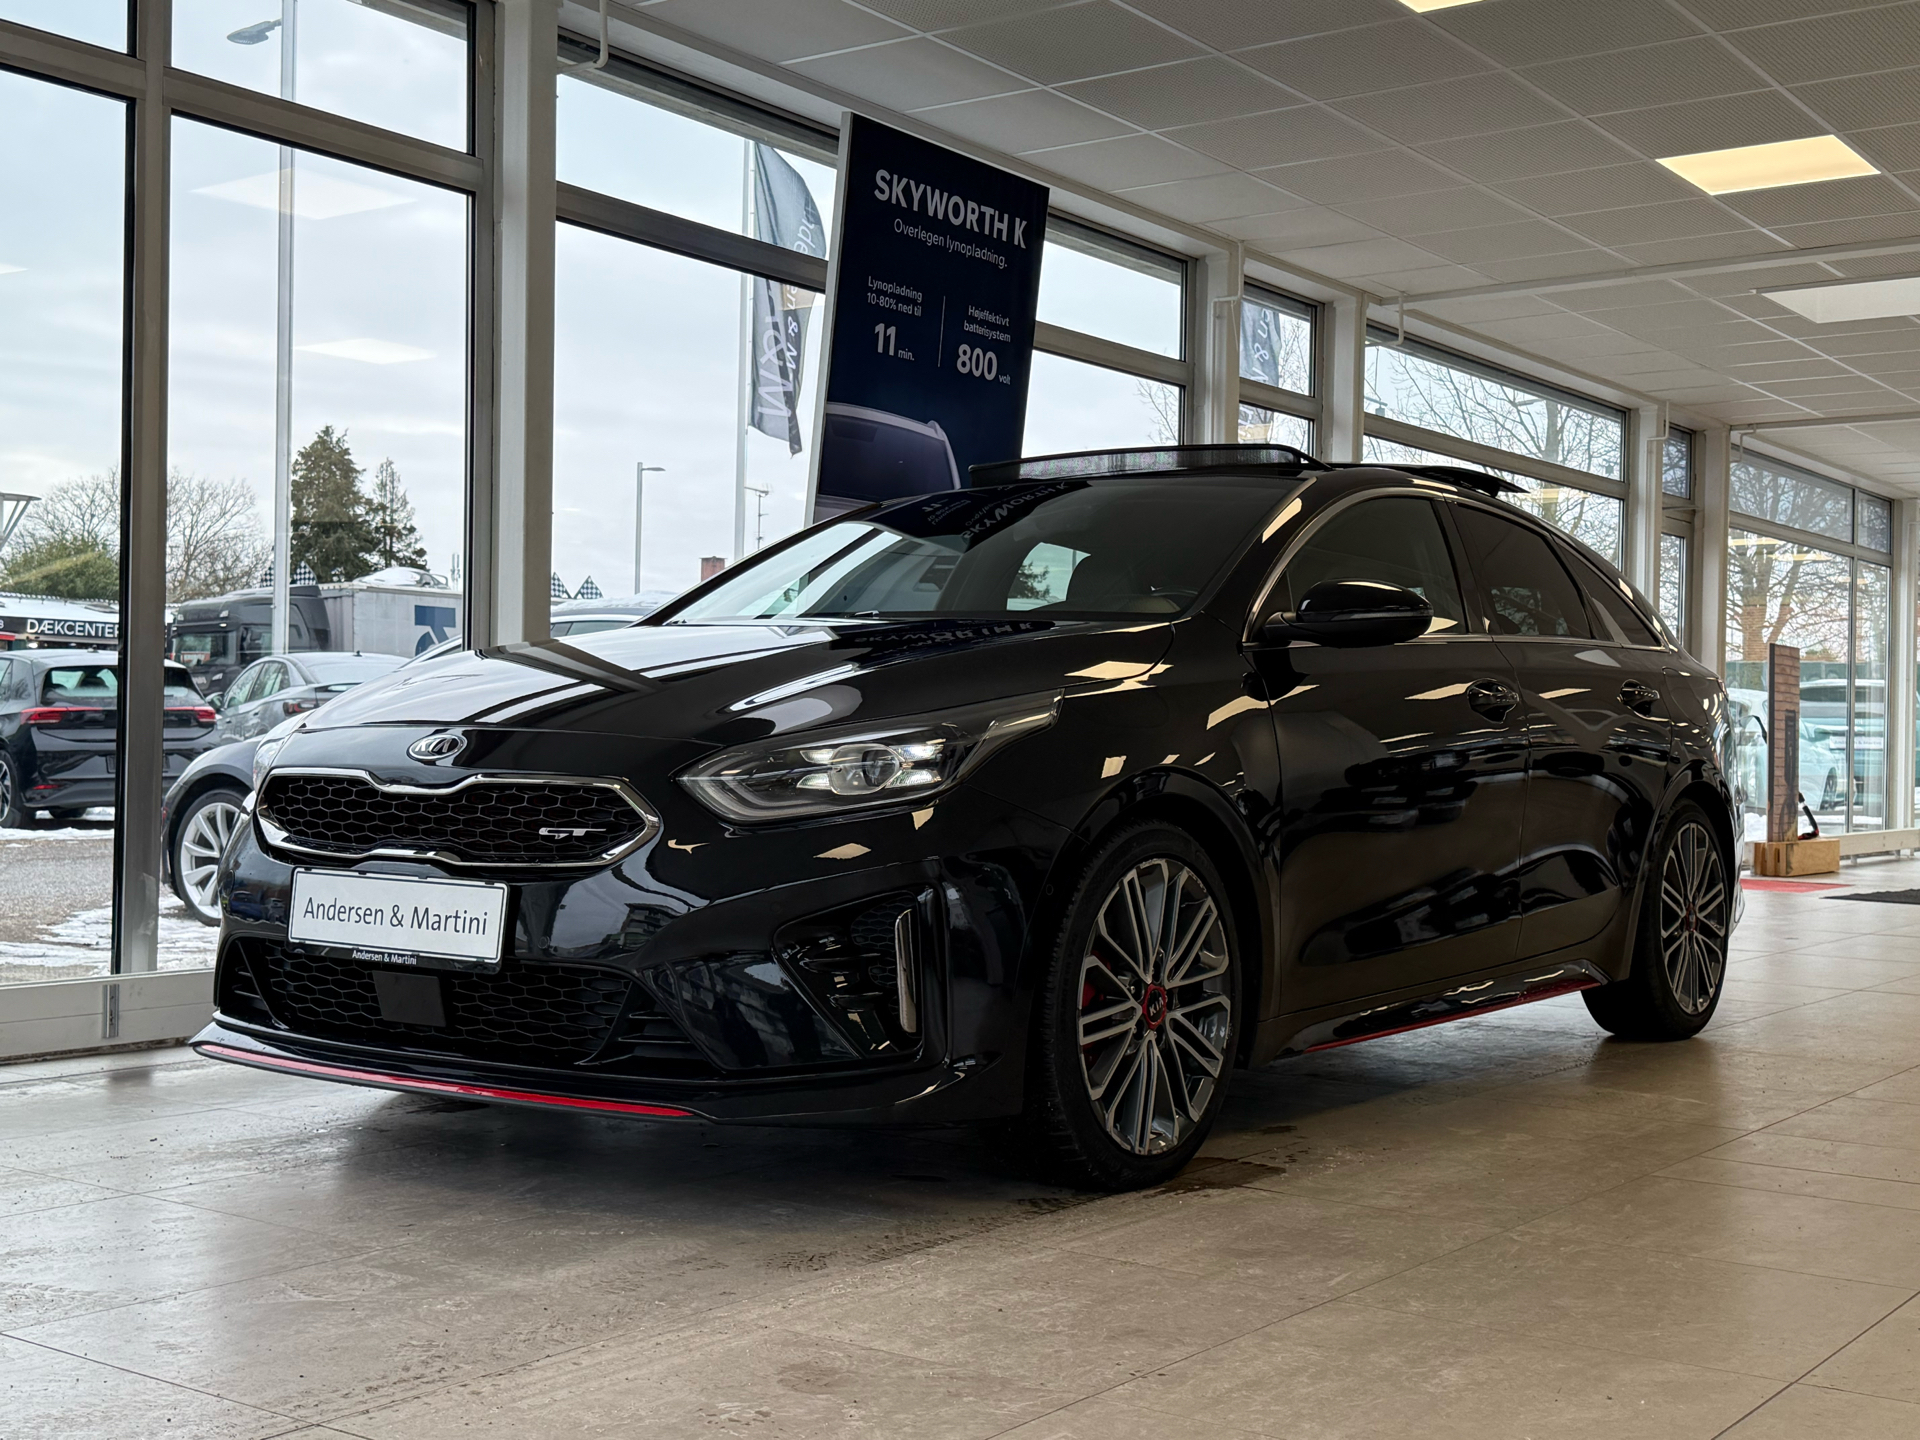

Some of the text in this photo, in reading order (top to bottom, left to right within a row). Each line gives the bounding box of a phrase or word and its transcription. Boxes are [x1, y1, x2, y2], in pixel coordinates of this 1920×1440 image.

[874, 169, 1028, 249] SKYWORTH K
[894, 218, 1008, 270] Overlegen lynopladning.
[868, 276, 923, 303] Lynopladning
[867, 293, 922, 317] 10-80% ned til
[968, 305, 1010, 327] Højeffektivt
[874, 323, 915, 361] 11 min.
[963, 320, 1011, 343] batterisystem
[956, 344, 1011, 385] 800 volt
[411, 736, 457, 755] KIA
[303, 897, 488, 935] Andersen & Martini
[352, 950, 417, 965] Andersen & Martini
[1149, 997, 1164, 1016] KIA
